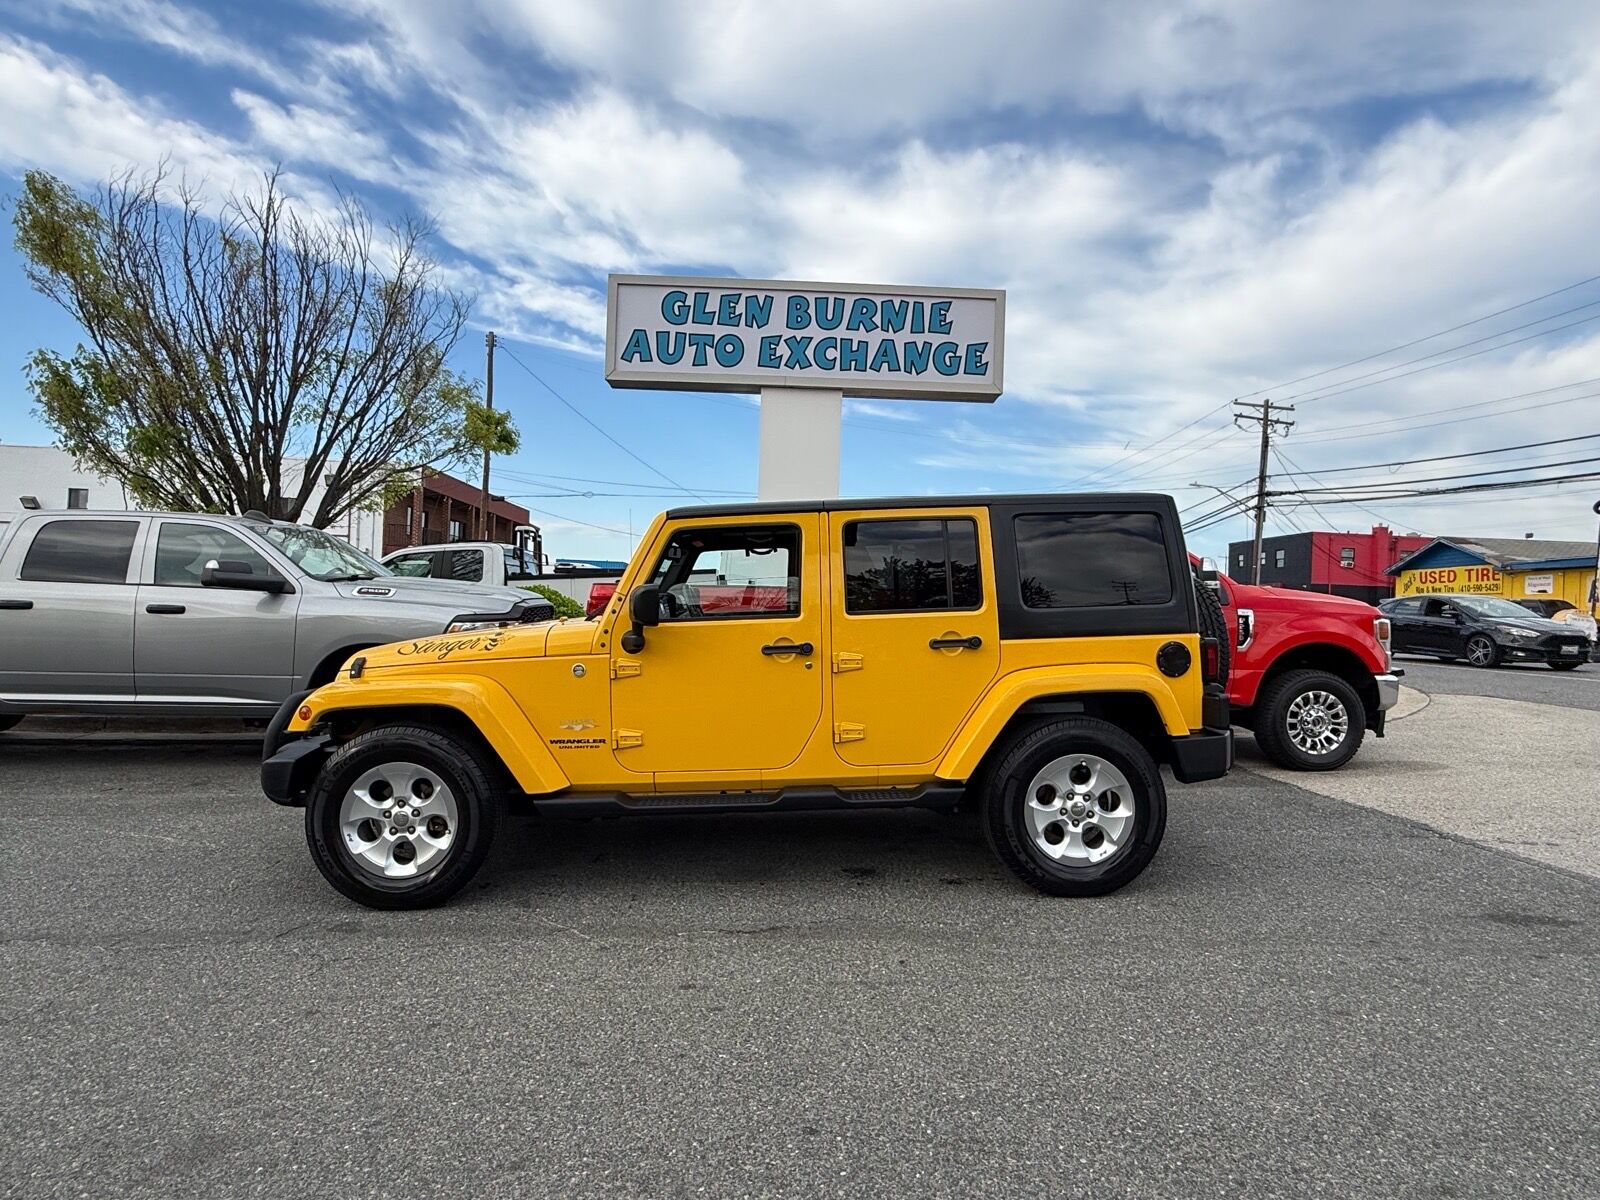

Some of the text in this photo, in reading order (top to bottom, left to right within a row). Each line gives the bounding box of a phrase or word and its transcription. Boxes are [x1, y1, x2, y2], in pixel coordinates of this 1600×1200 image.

[661, 290, 953, 335] GLEN BURNIE
[621, 329, 989, 376] AUTO EXCHANGE
[1420, 567, 1500, 584] USED TIRE
[1432, 585, 1442, 593] New
[397, 638, 481, 660] Stinger
